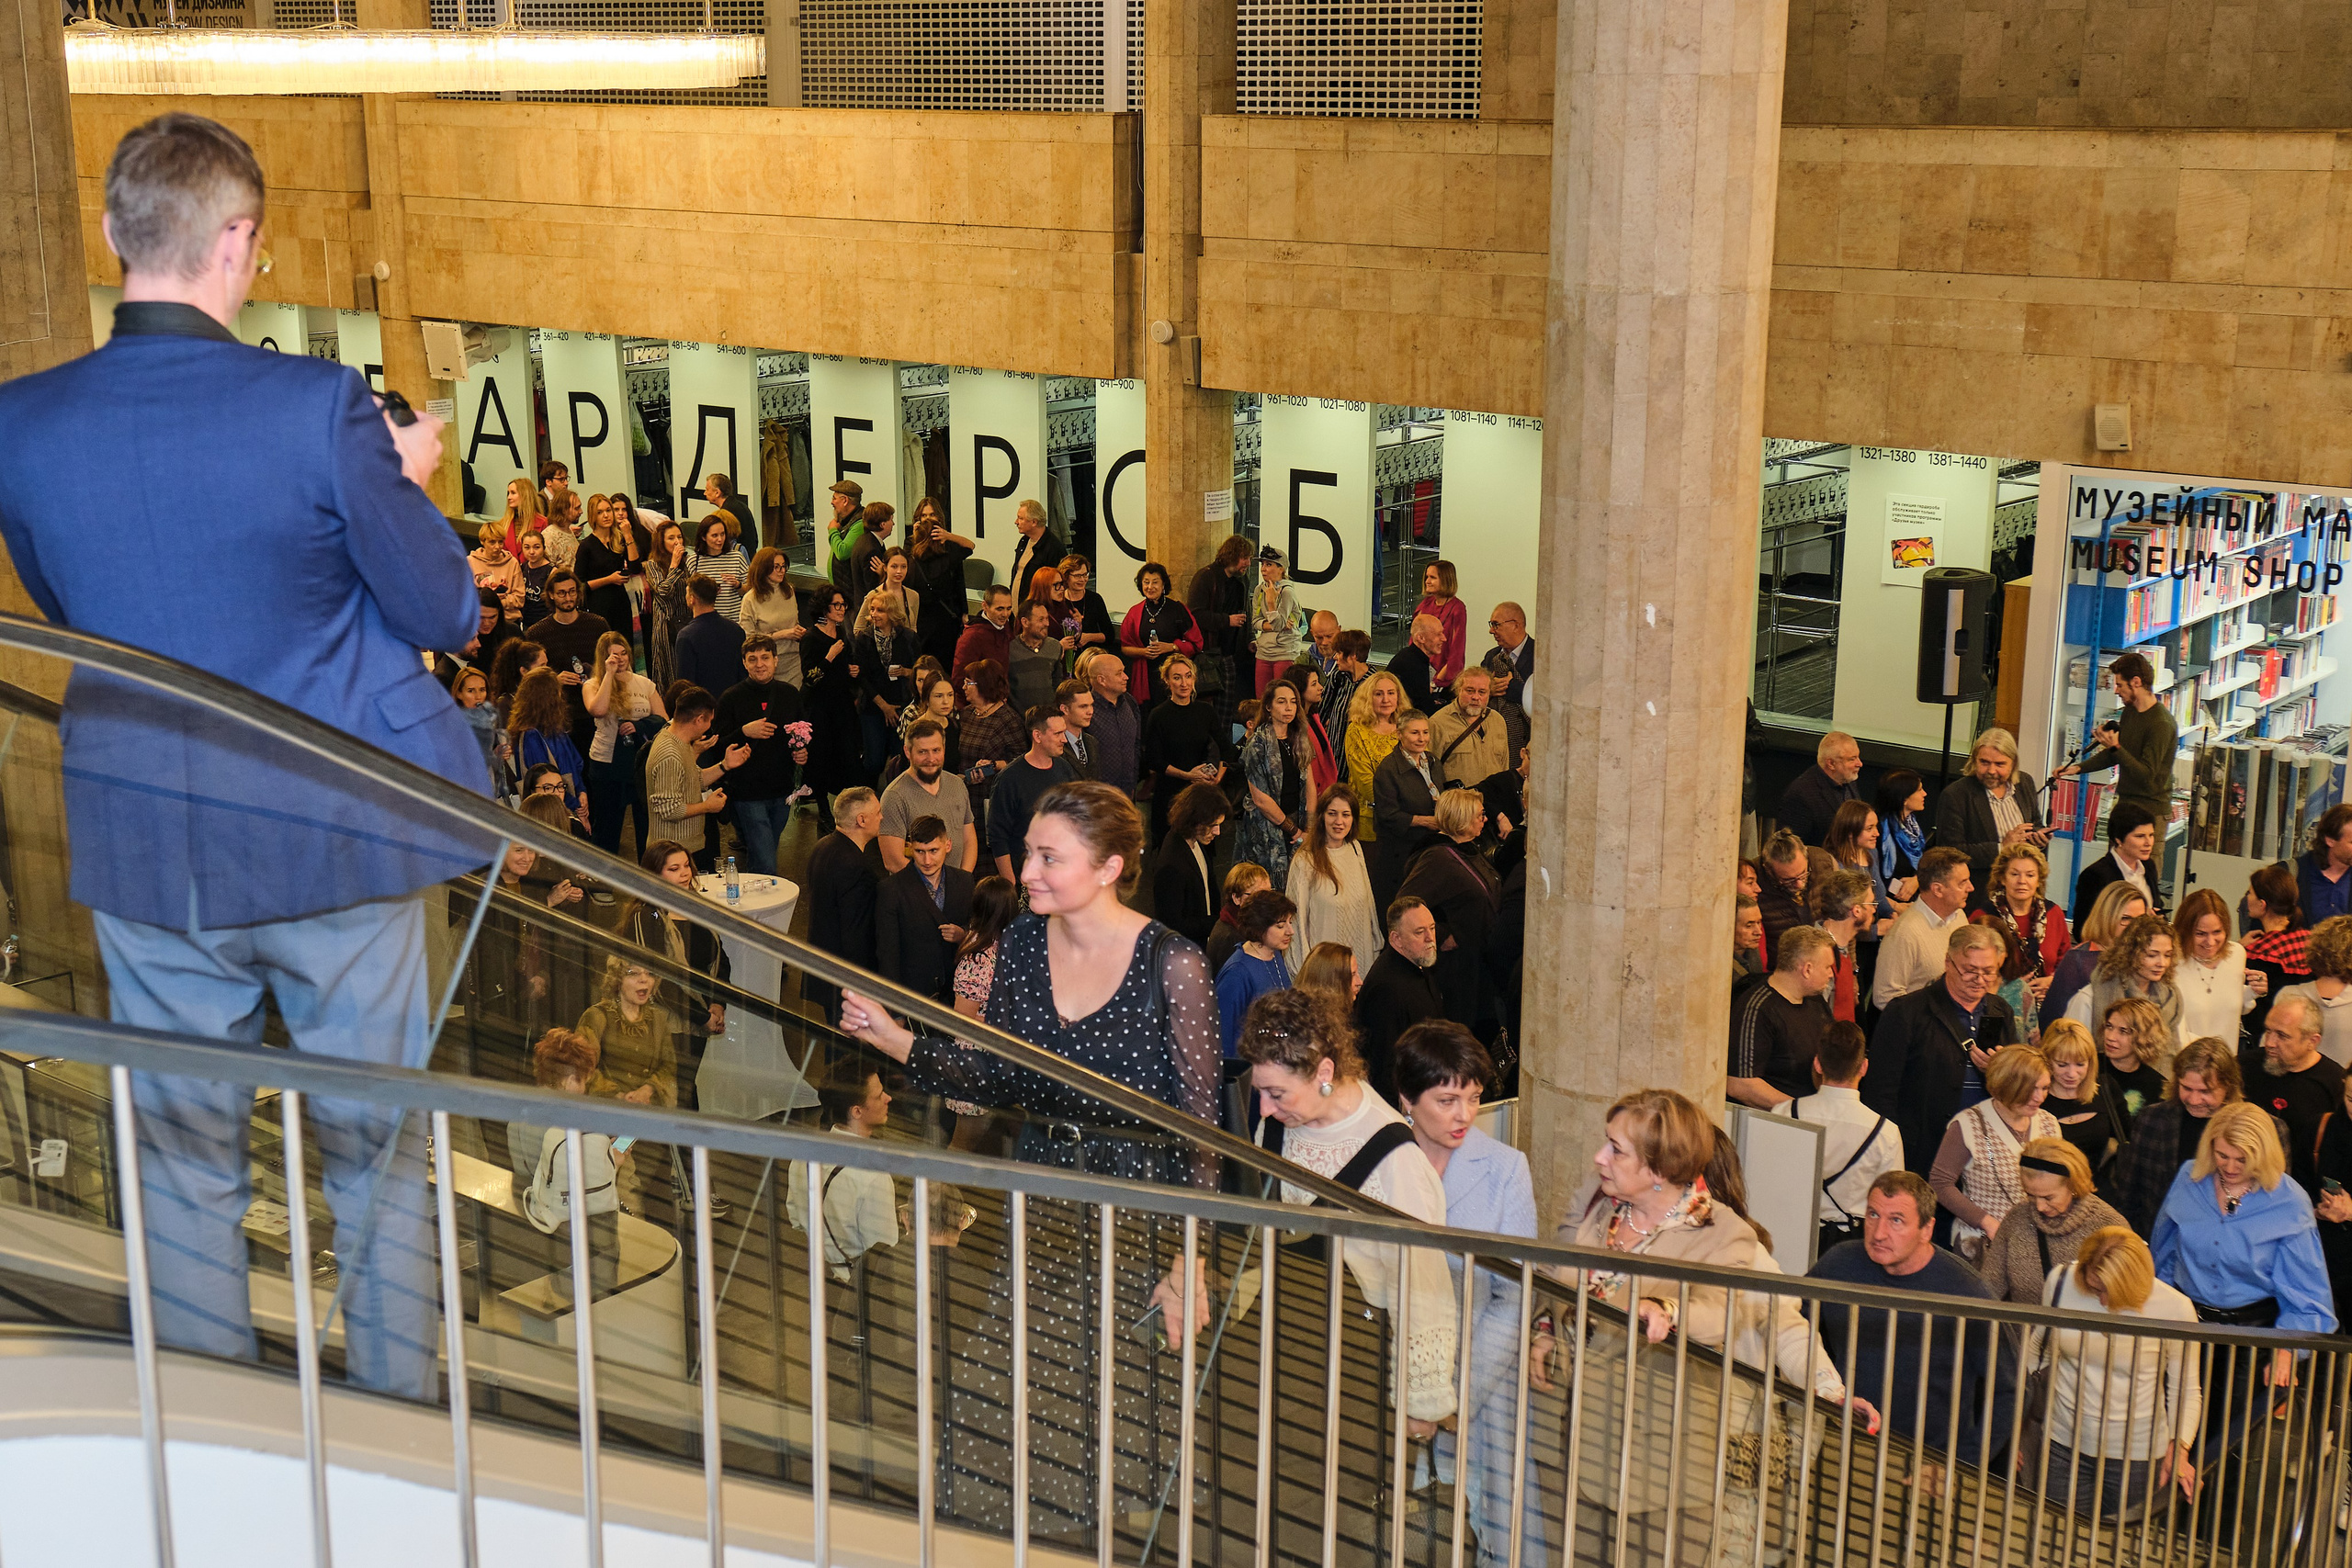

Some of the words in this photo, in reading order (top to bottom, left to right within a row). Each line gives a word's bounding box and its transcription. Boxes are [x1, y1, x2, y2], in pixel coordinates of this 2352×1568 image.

[206, 16, 243, 28] DESIGN
[543, 332, 570, 342] 361–420
[672, 341, 700, 352] 481–540
[717, 344, 747, 355] 541–600
[1100, 378, 1135, 390] 841–900
[1266, 393, 1308, 407] 961–1020
[1318, 397, 1366, 412] 1021–1080
[1450, 410, 1498, 426] 1081–1140
[1507, 416, 1544, 432] 1141–12
[1860, 446, 1917, 464] 1321–1380
[1928, 452, 1987, 469] 1381–1440
[2075, 485, 2277, 536] МУЗЕЙНЫЙ
[2072, 538, 2219, 583] MUSEUM
[2244, 555, 2343, 595] SHOP
